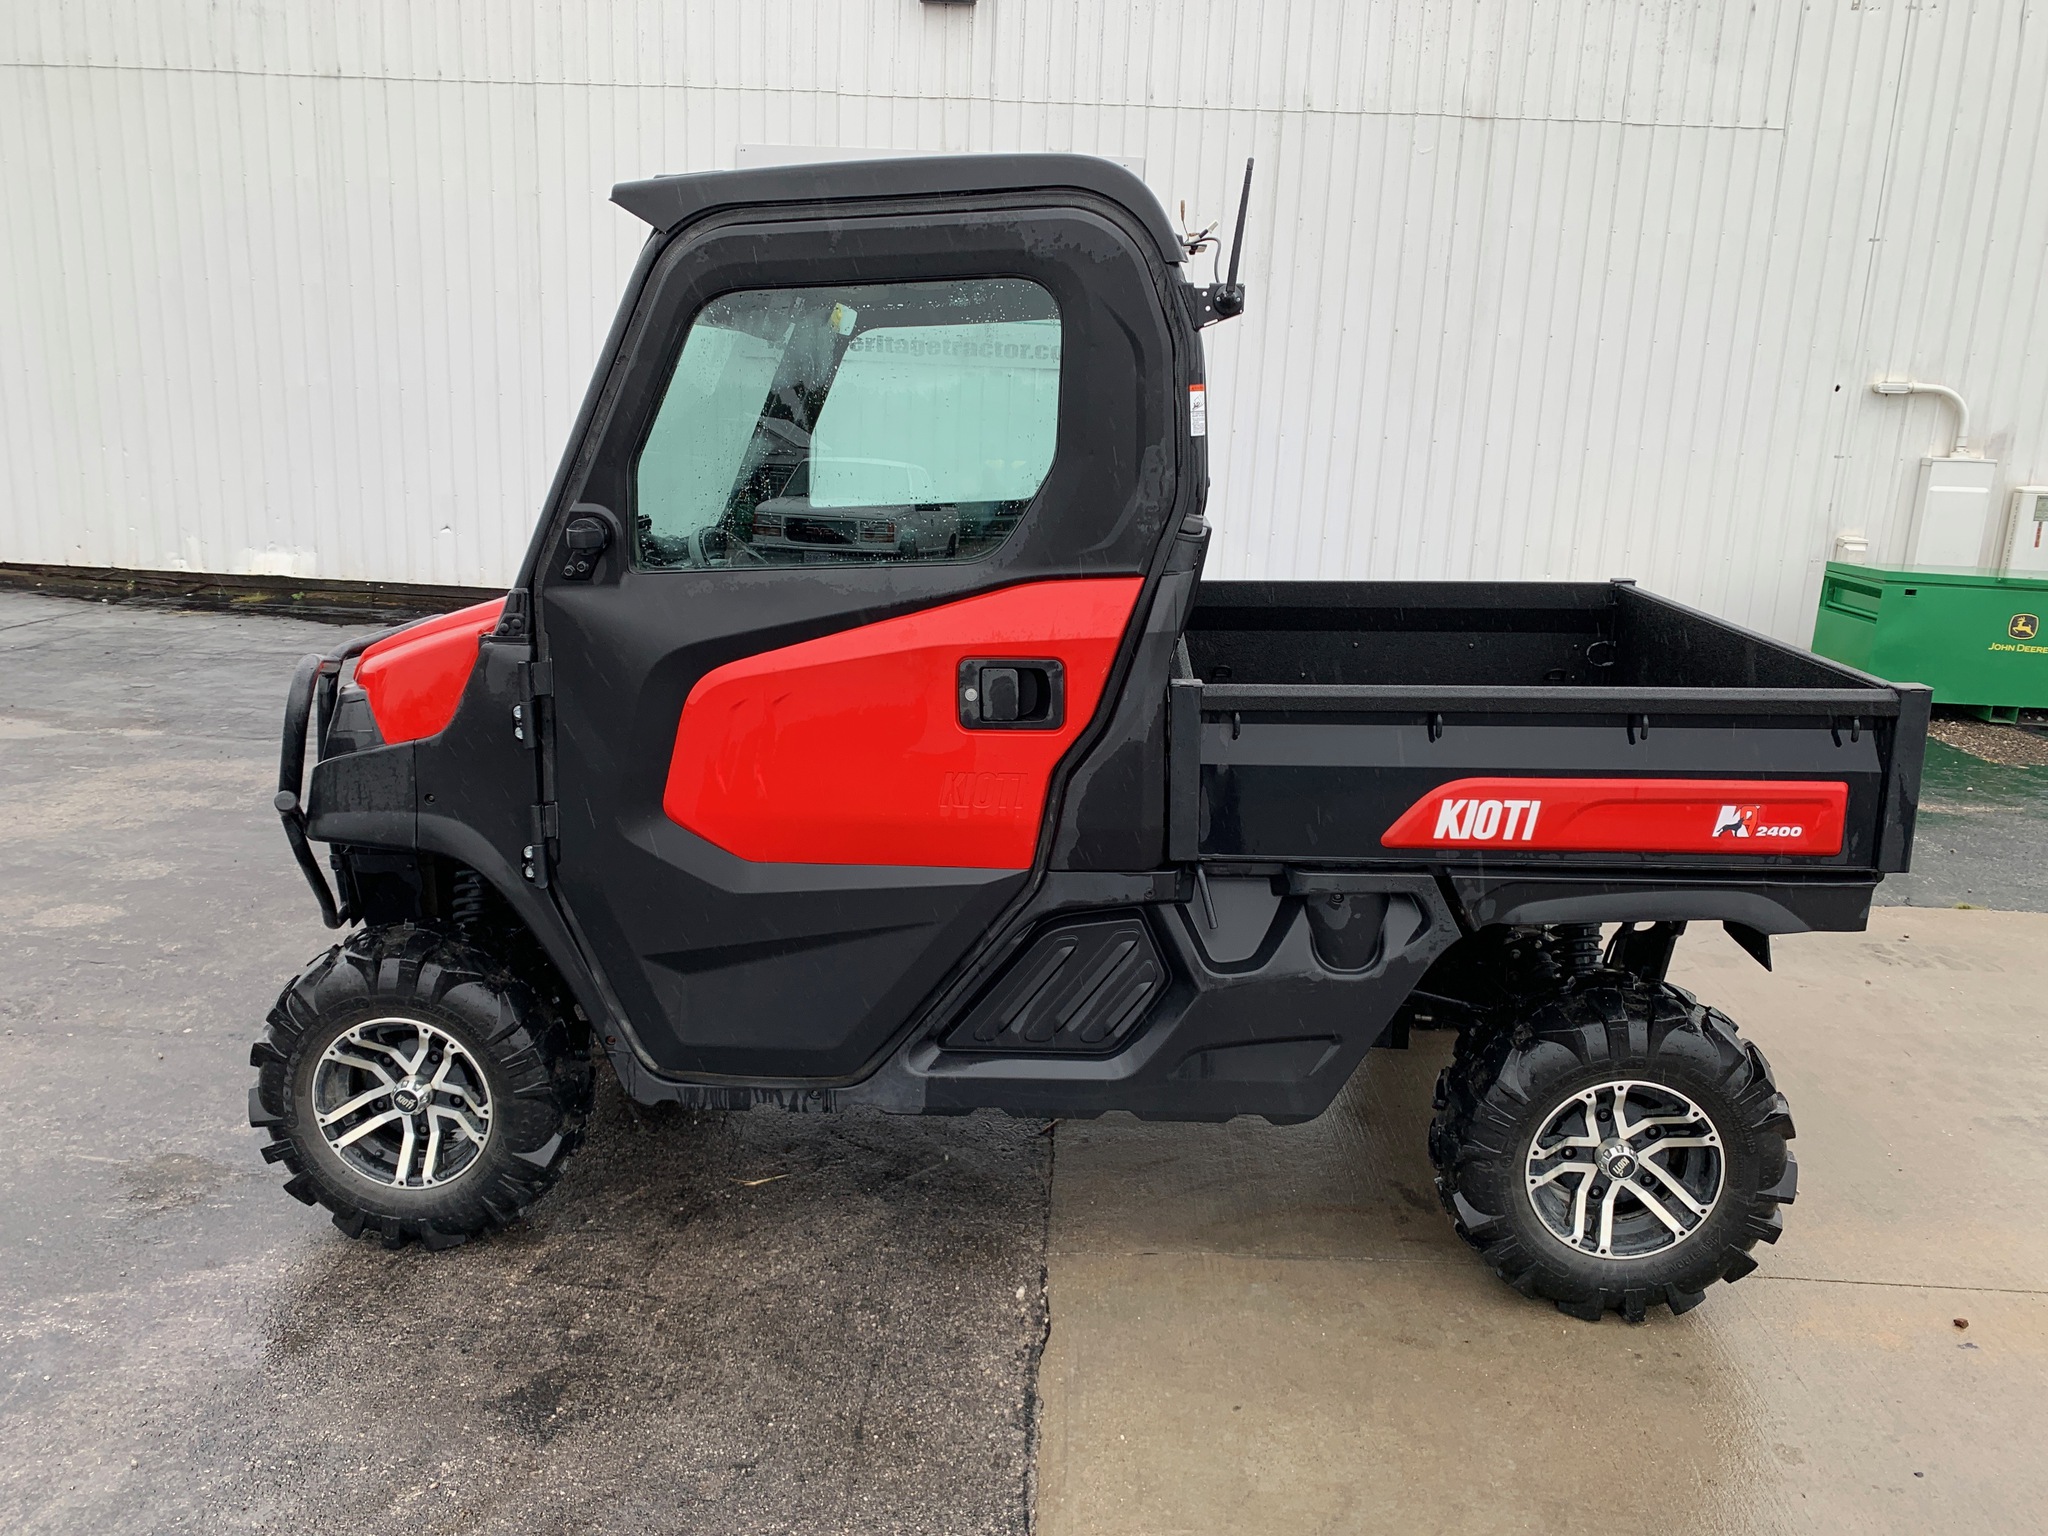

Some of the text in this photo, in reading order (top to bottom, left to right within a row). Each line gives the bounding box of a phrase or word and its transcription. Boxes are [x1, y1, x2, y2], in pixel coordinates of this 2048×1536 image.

[1987, 642, 2048, 654] JOHN DEERE
[939, 771, 1029, 809] KIOTI
[1432, 799, 1541, 841] KIOTI
[1712, 805, 1802, 837] K9 2400
[396, 1094, 415, 1110] KIOTI
[1612, 1156, 1630, 1174] KIOTI
